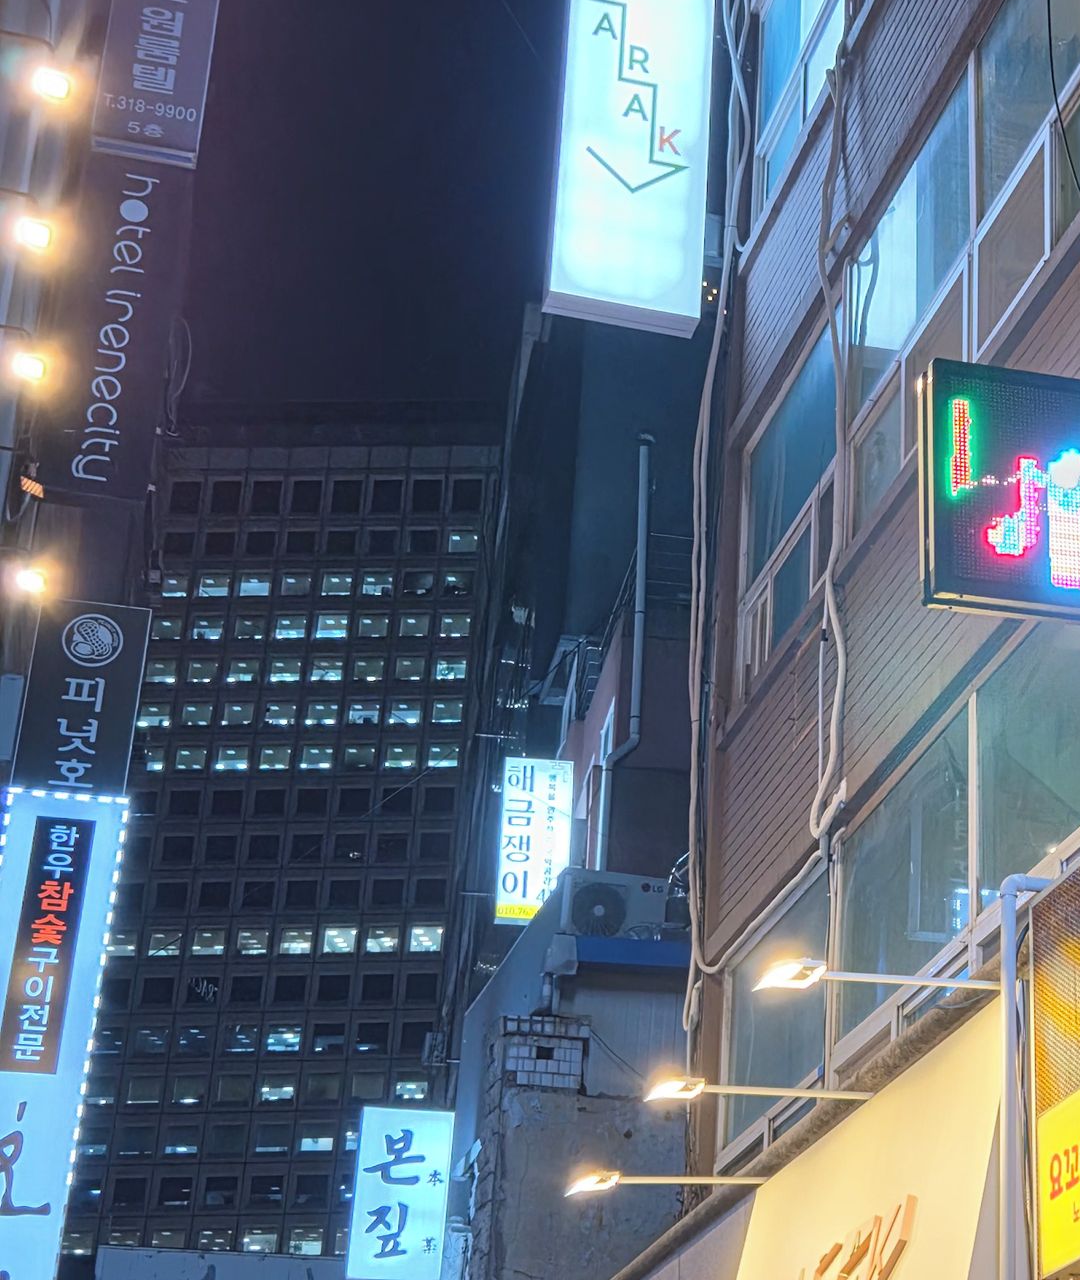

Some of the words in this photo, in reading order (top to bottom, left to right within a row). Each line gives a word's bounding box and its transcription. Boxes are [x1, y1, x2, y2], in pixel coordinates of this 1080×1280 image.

[103, 92, 197, 122] T.318-9900
[110, 173, 160, 273] hotel
[71, 288, 142, 482] irenecity
[502, 765, 536, 899] 해금쟁이
[363, 1128, 426, 1259] 본짚
